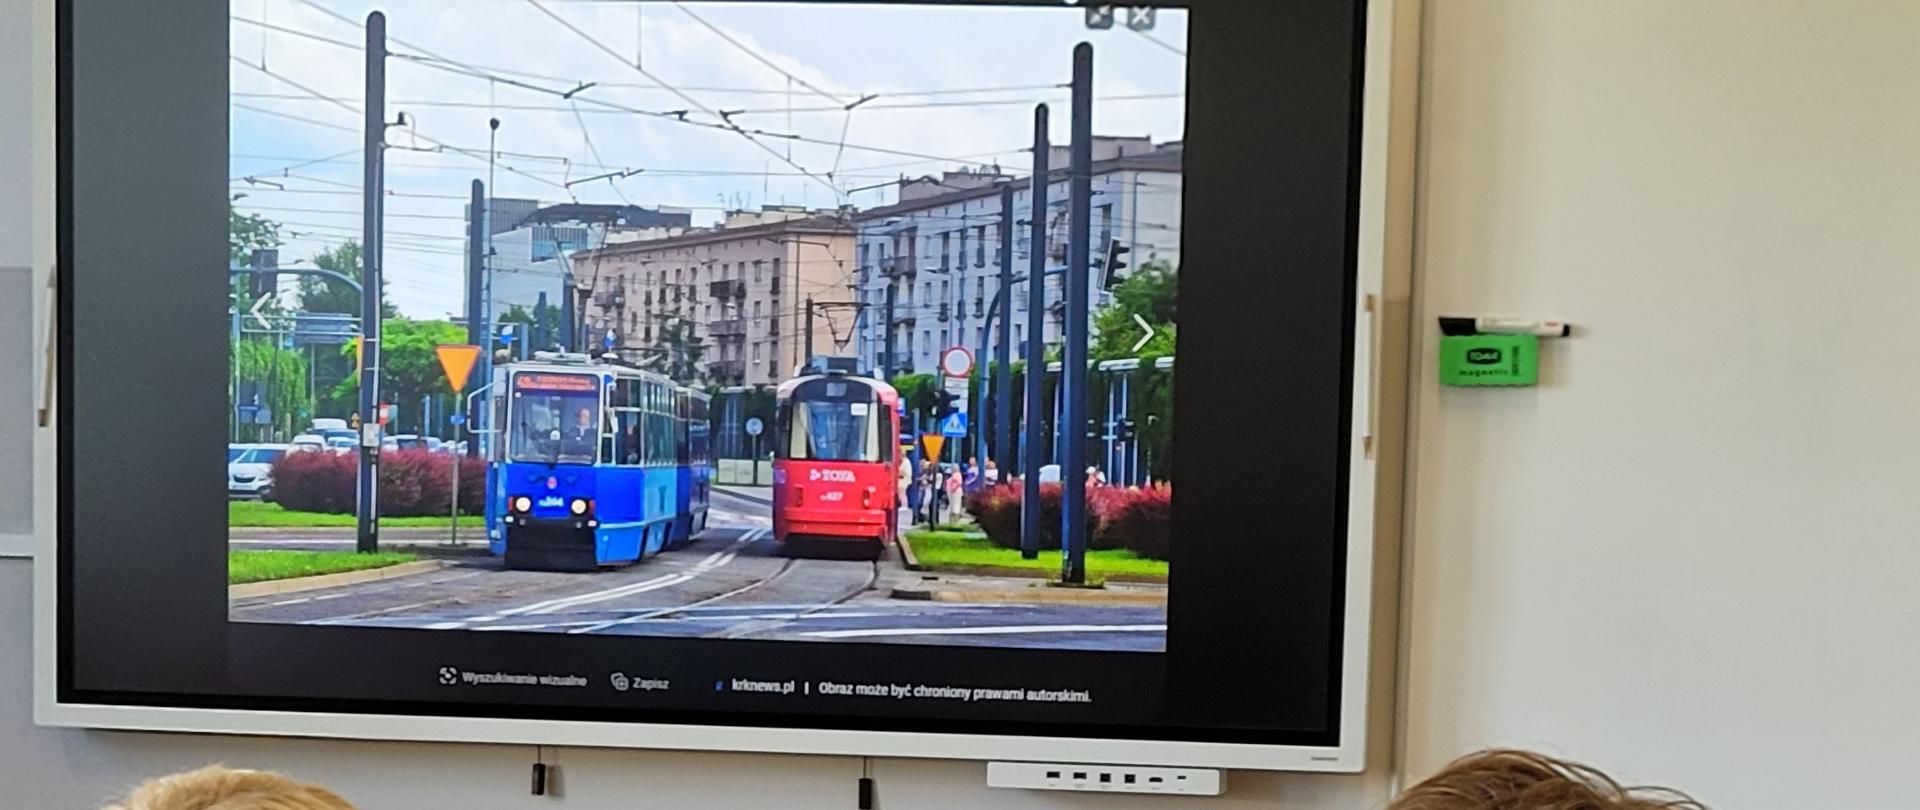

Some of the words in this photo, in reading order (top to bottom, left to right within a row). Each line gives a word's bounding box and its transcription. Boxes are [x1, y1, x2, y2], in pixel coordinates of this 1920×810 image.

[1459, 369, 1508, 378] magnetic
[461, 672, 537, 685] Wyszukiwanie
[540, 674, 588, 687] wizualne
[633, 677, 670, 691] Zapisz
[732, 678, 795, 695] krknews.pl
[818, 682, 854, 695] Obraz
[855, 683, 889, 696] może
[891, 683, 912, 699] być
[913, 684, 972, 701] chroniony
[973, 688, 1025, 702] prawami
[1026, 689, 1093, 703] autorskimi.
